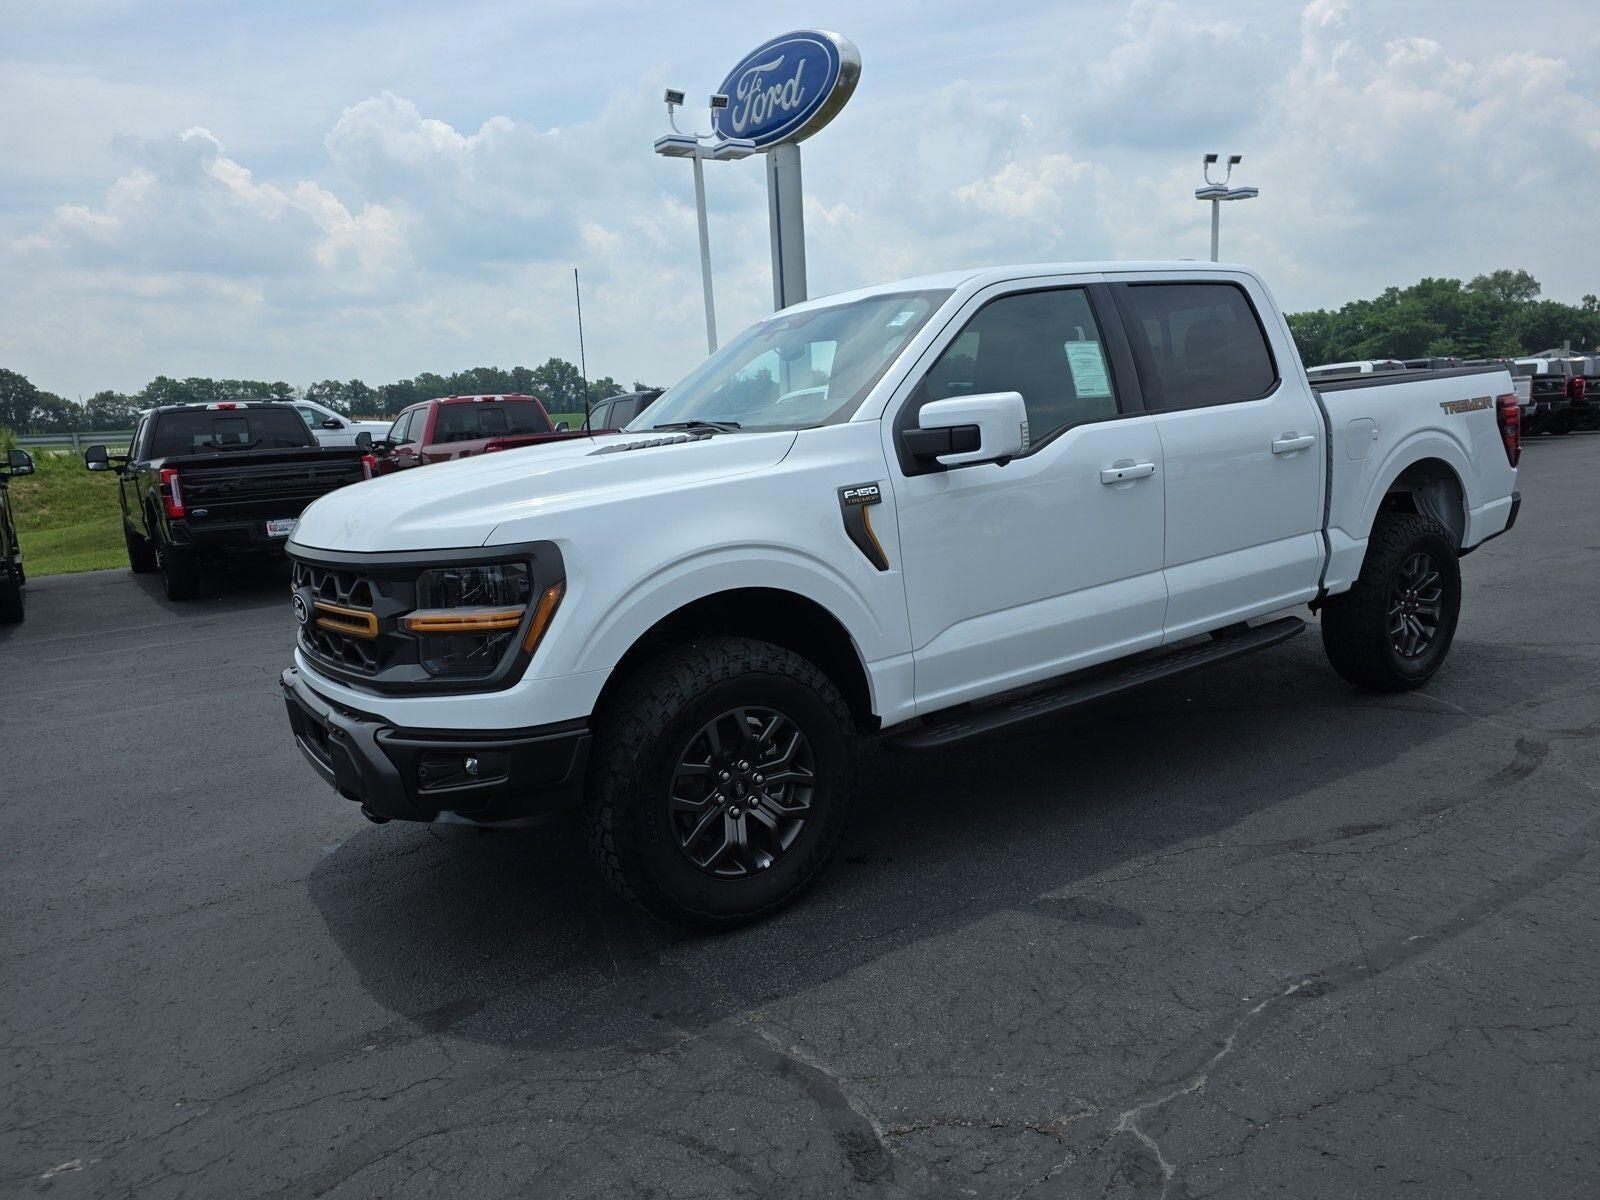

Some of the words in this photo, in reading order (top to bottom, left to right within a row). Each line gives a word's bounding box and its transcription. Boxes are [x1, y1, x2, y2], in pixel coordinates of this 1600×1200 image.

[731, 54, 806, 132] Ford
[1439, 395, 1493, 415] TREMOR
[843, 486, 879, 499] F-150
